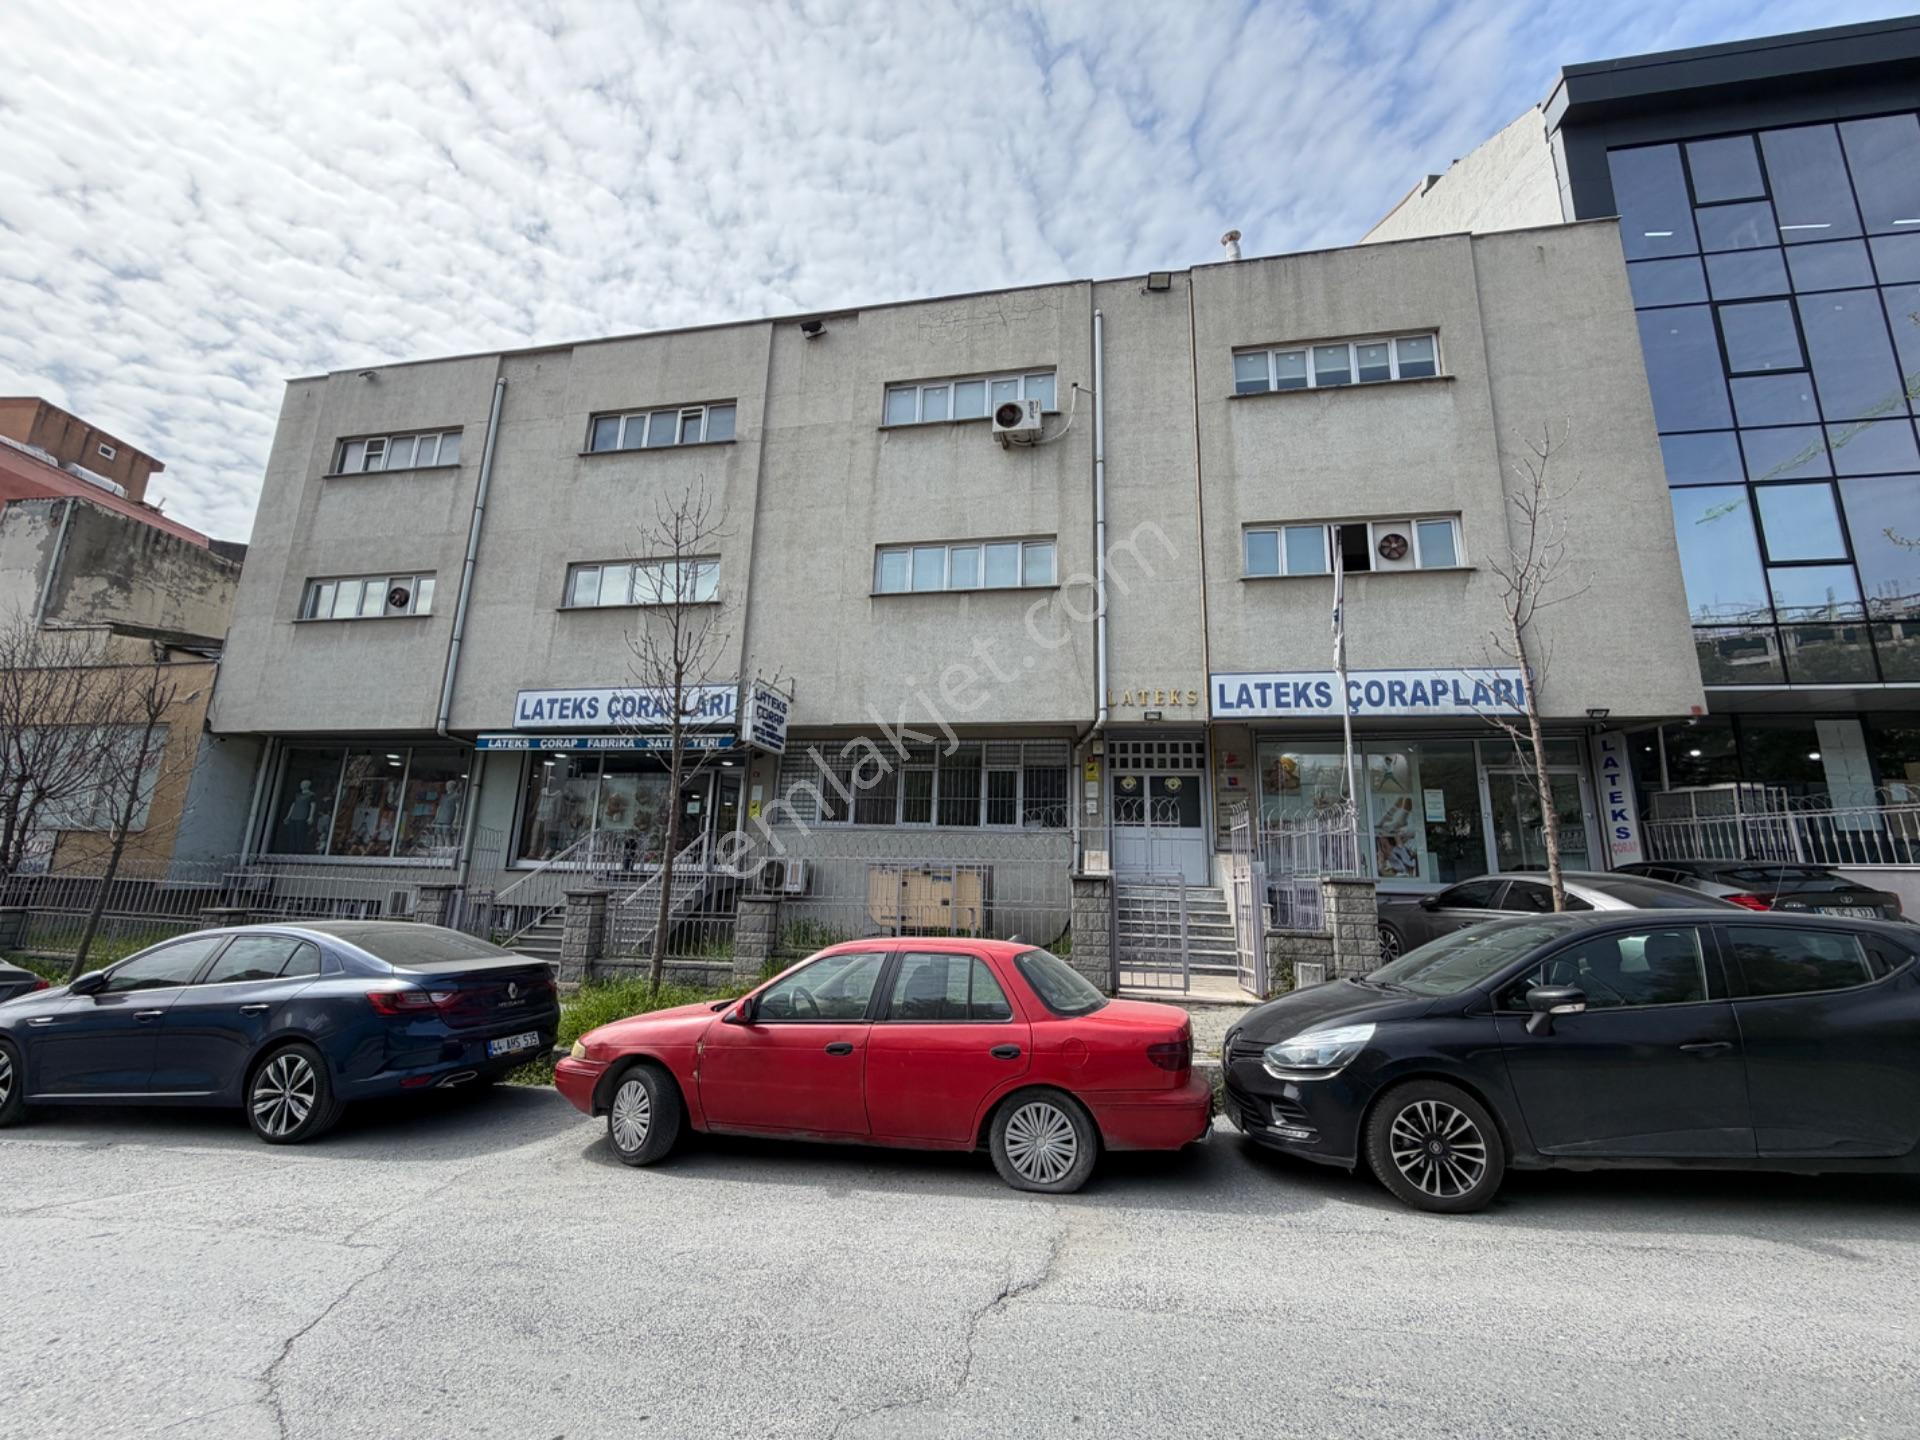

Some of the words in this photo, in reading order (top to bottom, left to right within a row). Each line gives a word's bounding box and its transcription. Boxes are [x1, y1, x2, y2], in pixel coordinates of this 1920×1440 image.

[520, 696, 599, 720] LATEKS
[755, 687, 788, 715] LATEKS
[1106, 687, 1198, 706] LATEKS
[1218, 680, 1332, 709] LATEKS
[1346, 678, 1525, 714] ÇORAPLARI
[487, 739, 529, 749] LATEKS
[540, 739, 578, 750] ÇORAP
[647, 738, 676, 749] SATI
[1602, 740, 1631, 840] LATEKS
